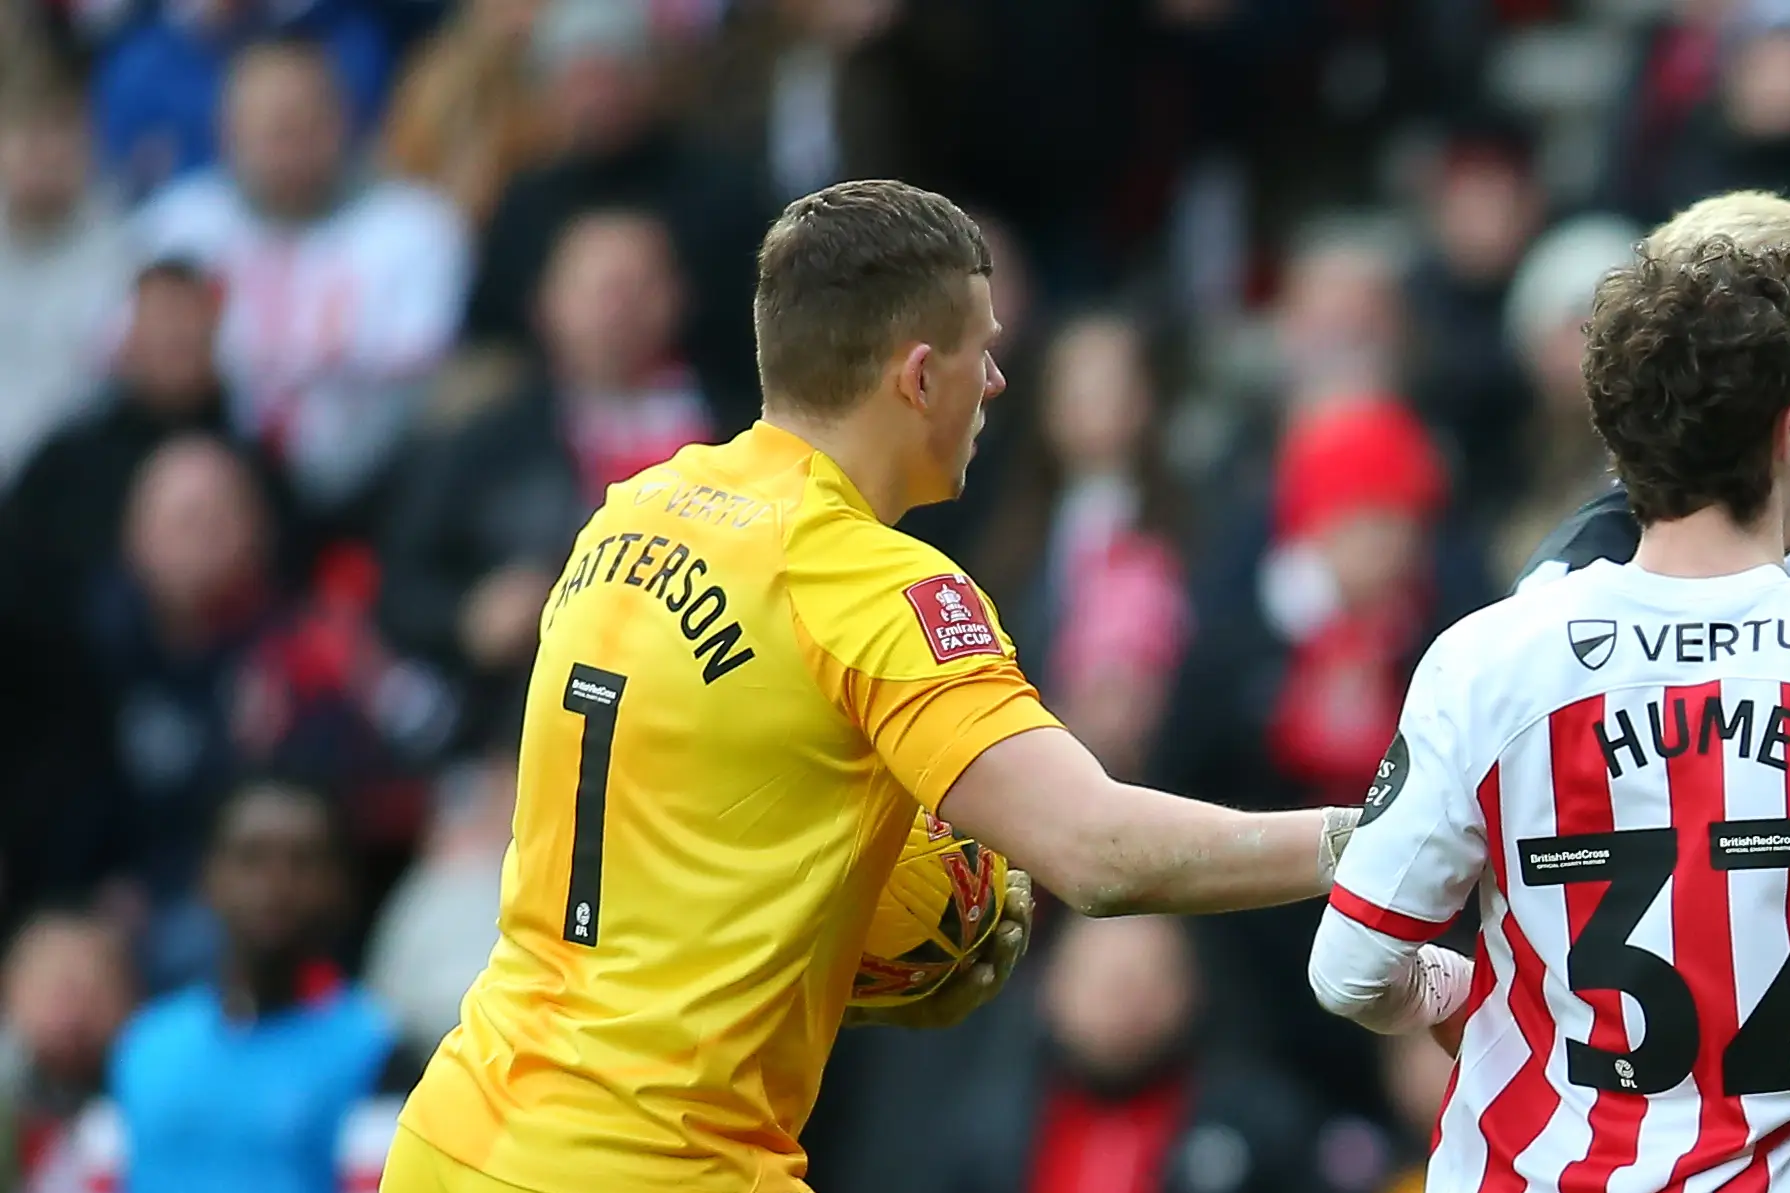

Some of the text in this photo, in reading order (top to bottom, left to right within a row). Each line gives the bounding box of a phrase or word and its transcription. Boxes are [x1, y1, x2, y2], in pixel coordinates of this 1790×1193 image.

[664, 482, 773, 529] VERTU
[935, 622, 989, 639] Emirates
[940, 633, 992, 651] FA CUP
[562, 662, 627, 947] 1
[1529, 849, 1610, 864] BritishRedCross
[1620, 1078, 1638, 1089] EFL
